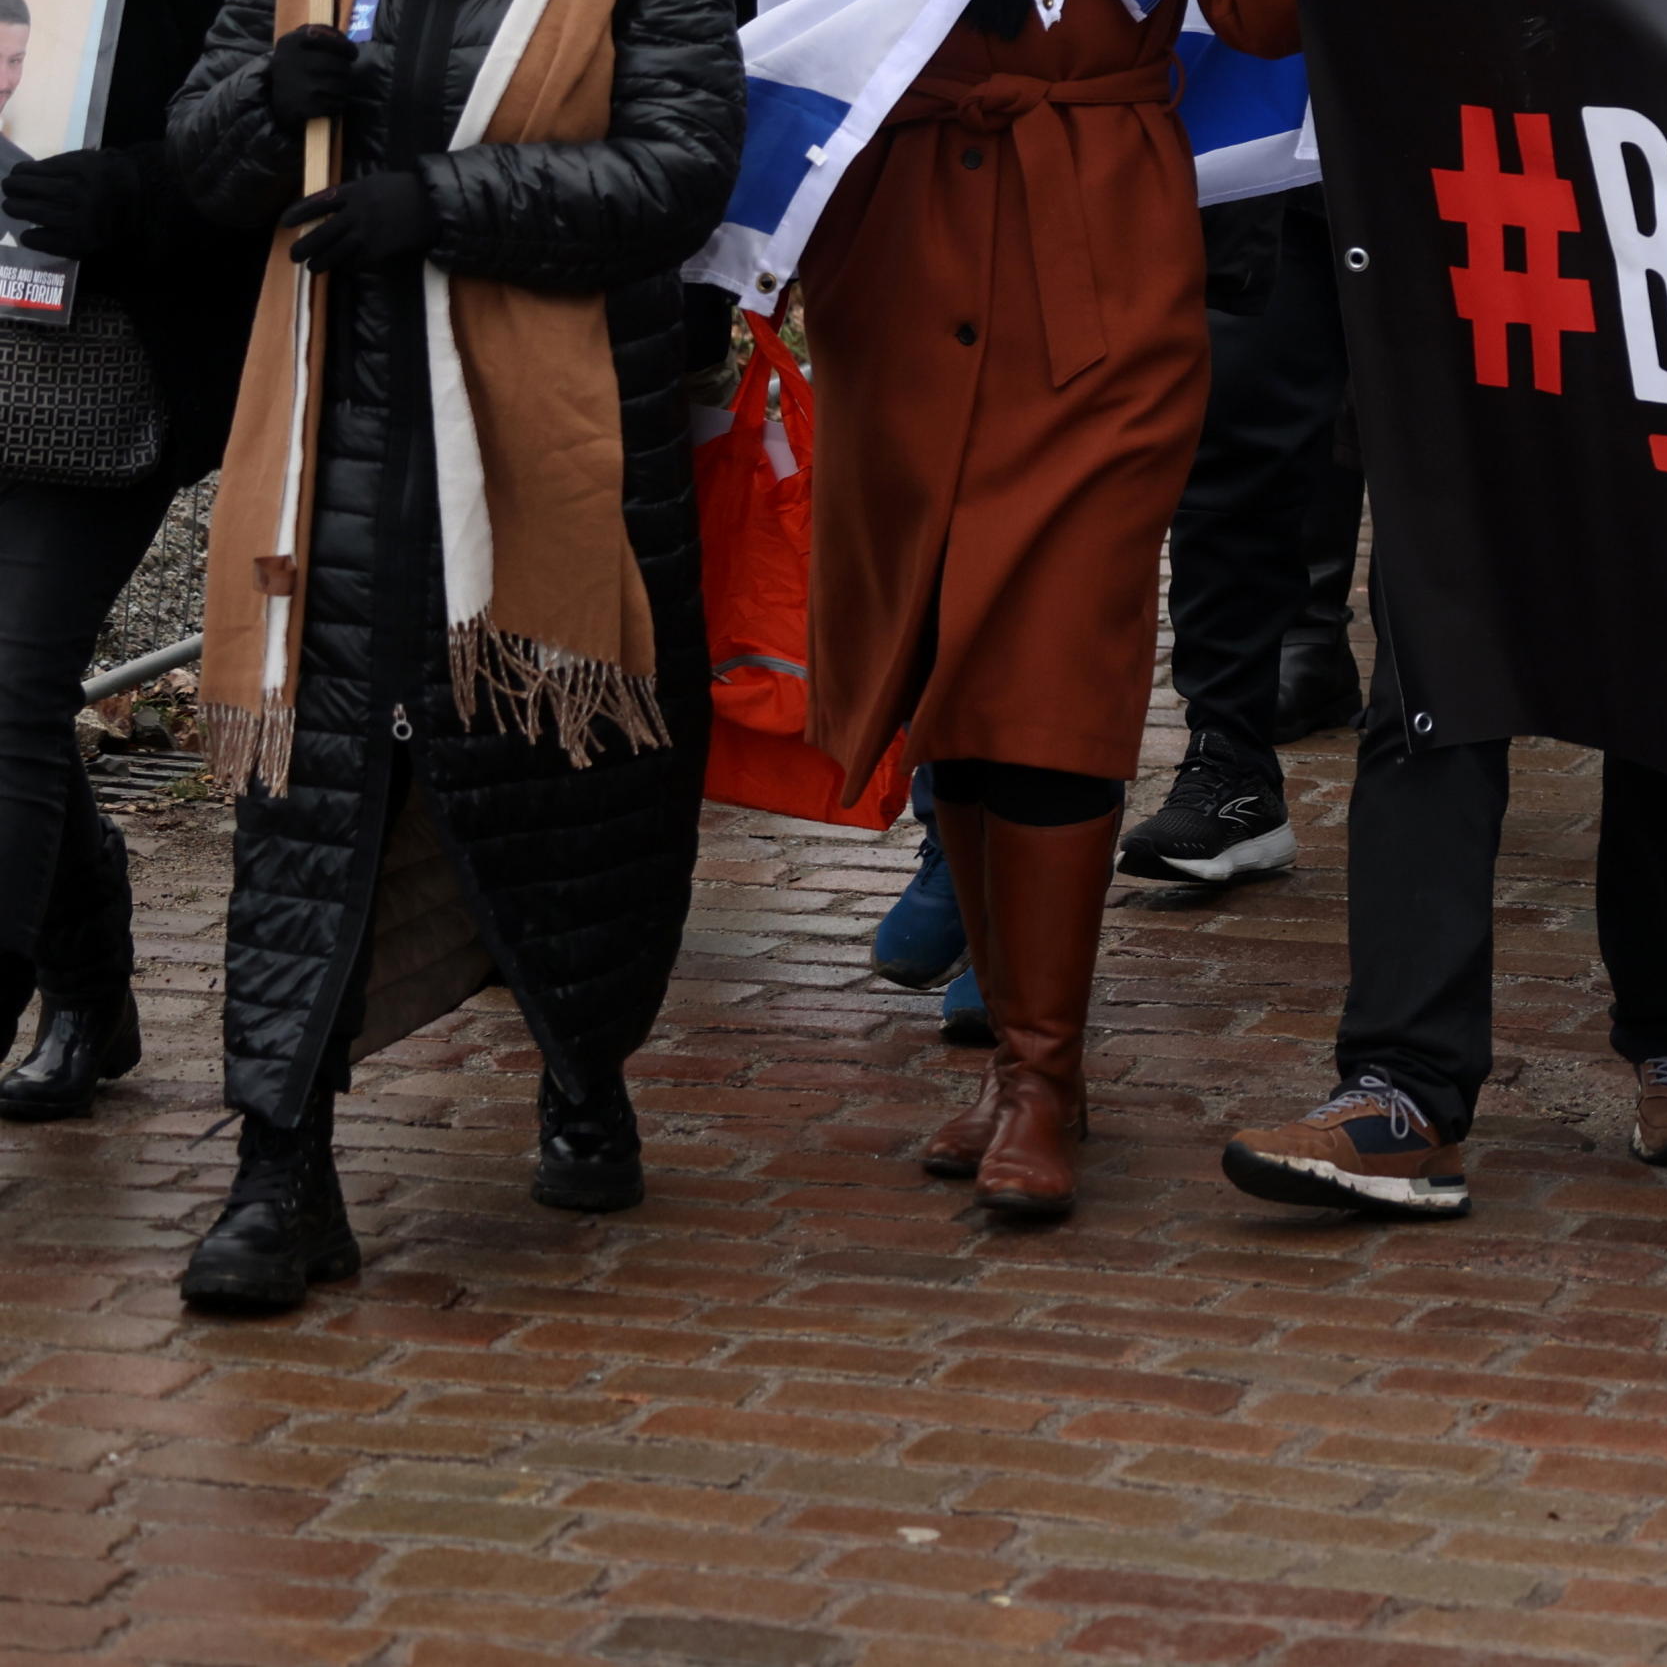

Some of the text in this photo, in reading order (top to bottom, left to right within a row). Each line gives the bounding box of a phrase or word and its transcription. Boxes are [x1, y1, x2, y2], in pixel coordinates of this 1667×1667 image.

[17, 268, 33, 283] AND
[33, 270, 65, 286] MISSING
[25, 283, 63, 306] FORUM
